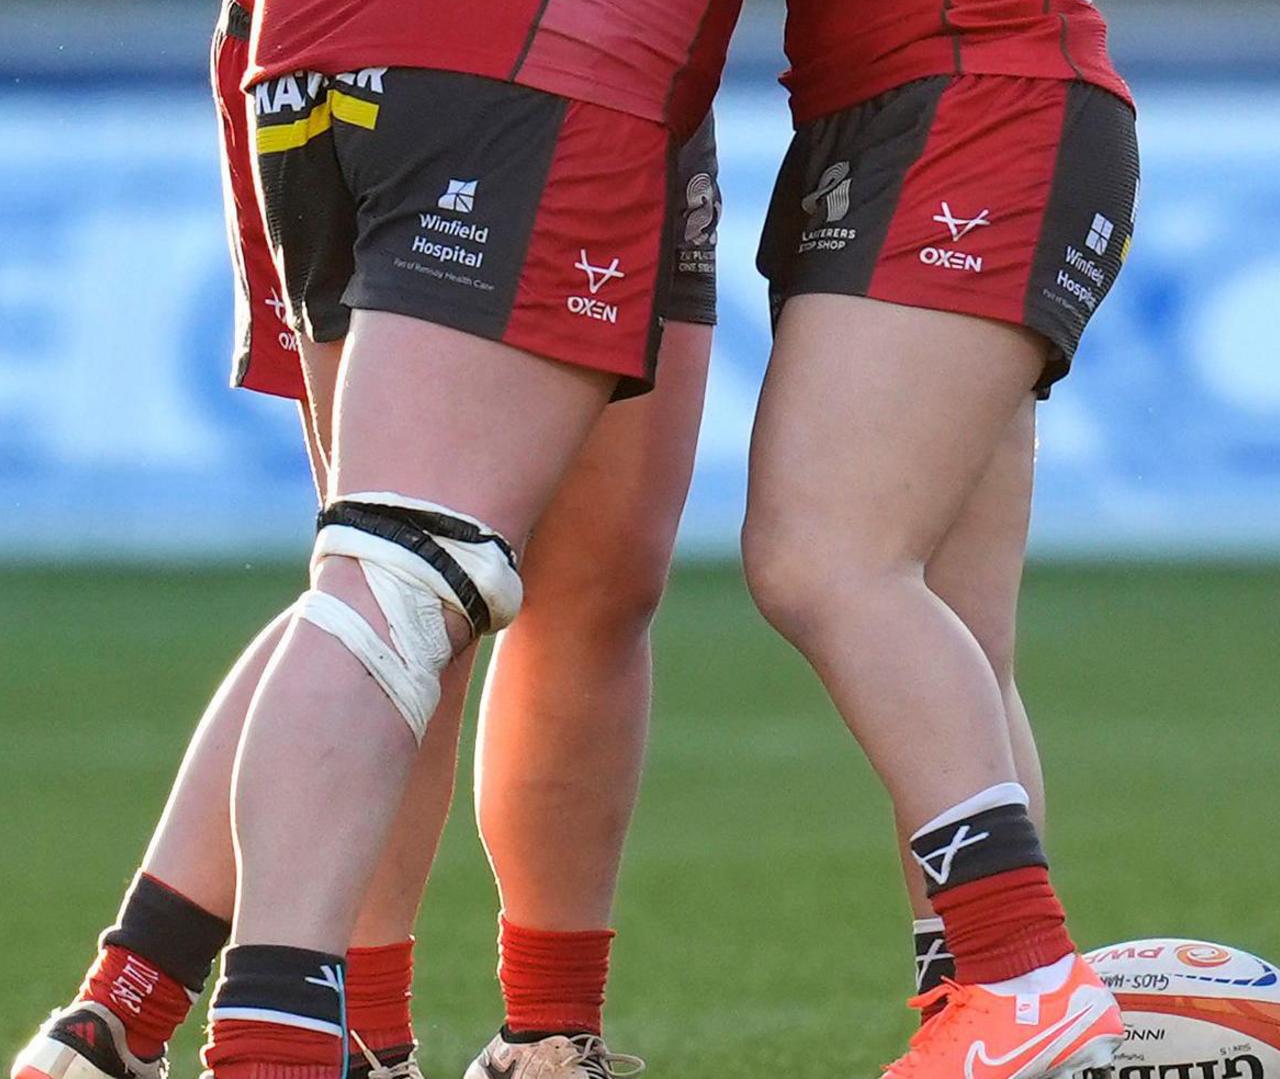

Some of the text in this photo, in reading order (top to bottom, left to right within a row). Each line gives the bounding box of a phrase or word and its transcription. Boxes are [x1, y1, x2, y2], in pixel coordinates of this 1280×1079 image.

[419, 213, 489, 244] Winfield
[411, 235, 484, 269] Hospital
[920, 247, 983, 273] OXEN
[567, 296, 619, 324] OXEN
